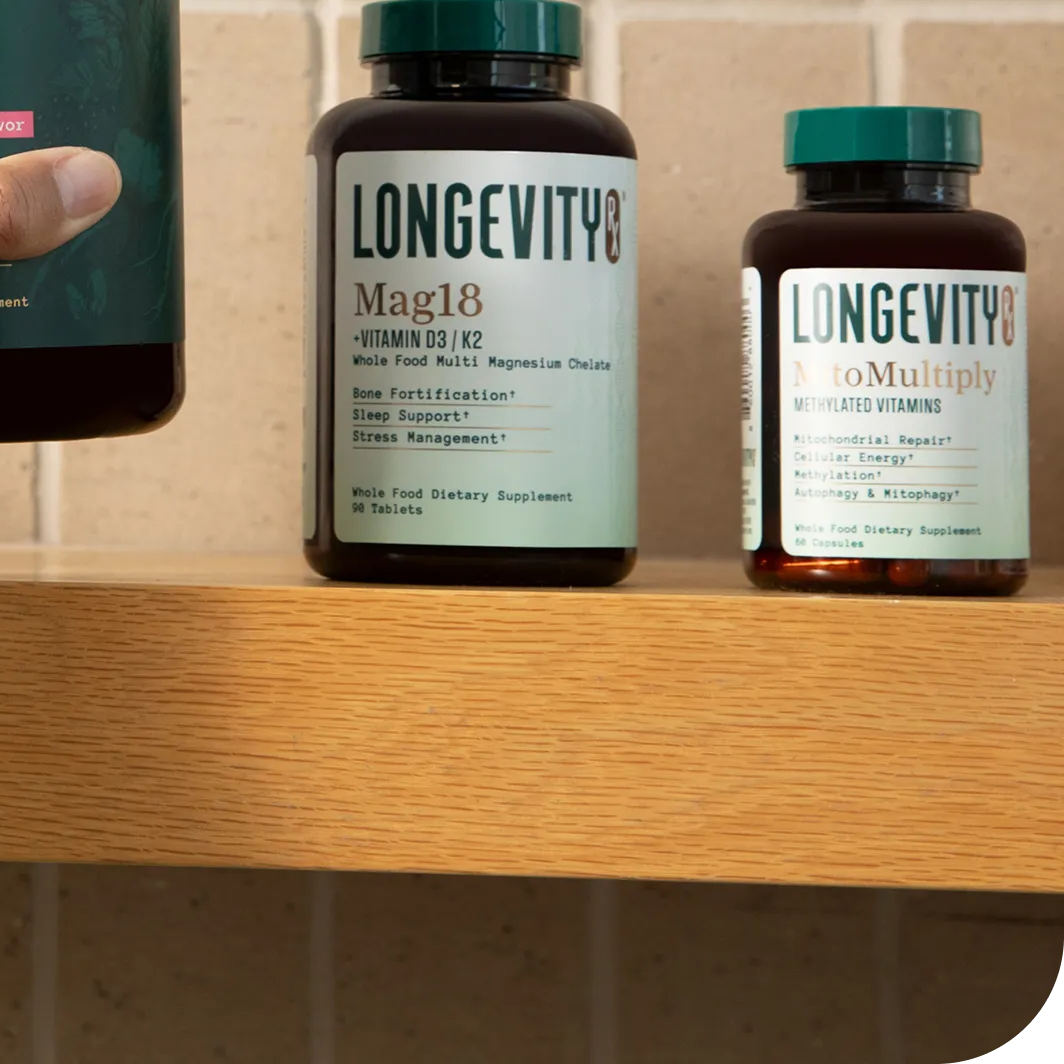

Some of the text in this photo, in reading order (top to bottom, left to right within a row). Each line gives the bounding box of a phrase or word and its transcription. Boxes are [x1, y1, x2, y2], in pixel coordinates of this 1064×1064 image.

[353, 182, 601, 262] LONGEVITY
[353, 282, 483, 325] Mag18
[793, 282, 998, 346] LONGEVITY
[426, 329, 447, 349] D3
[462, 330, 483, 349] K2
[353, 354, 612, 371] Whole Food Multi Magnesium Chelate
[353, 387, 382, 400] Bone
[794, 397, 942, 414] METHYLATED VITAMINS
[353, 409, 390, 423] Sleep
[353, 431, 398, 443] Stress
[352, 487, 573, 504] Whole Food Dietary Supplement
[794, 488, 859, 500] Autophagy
[867, 489, 875, 498] &
[352, 502, 423, 515] 90 Tablets
[830, 524, 857, 534] Food
[864, 525, 913, 537] Dietary
[920, 526, 982, 536] Supplement
